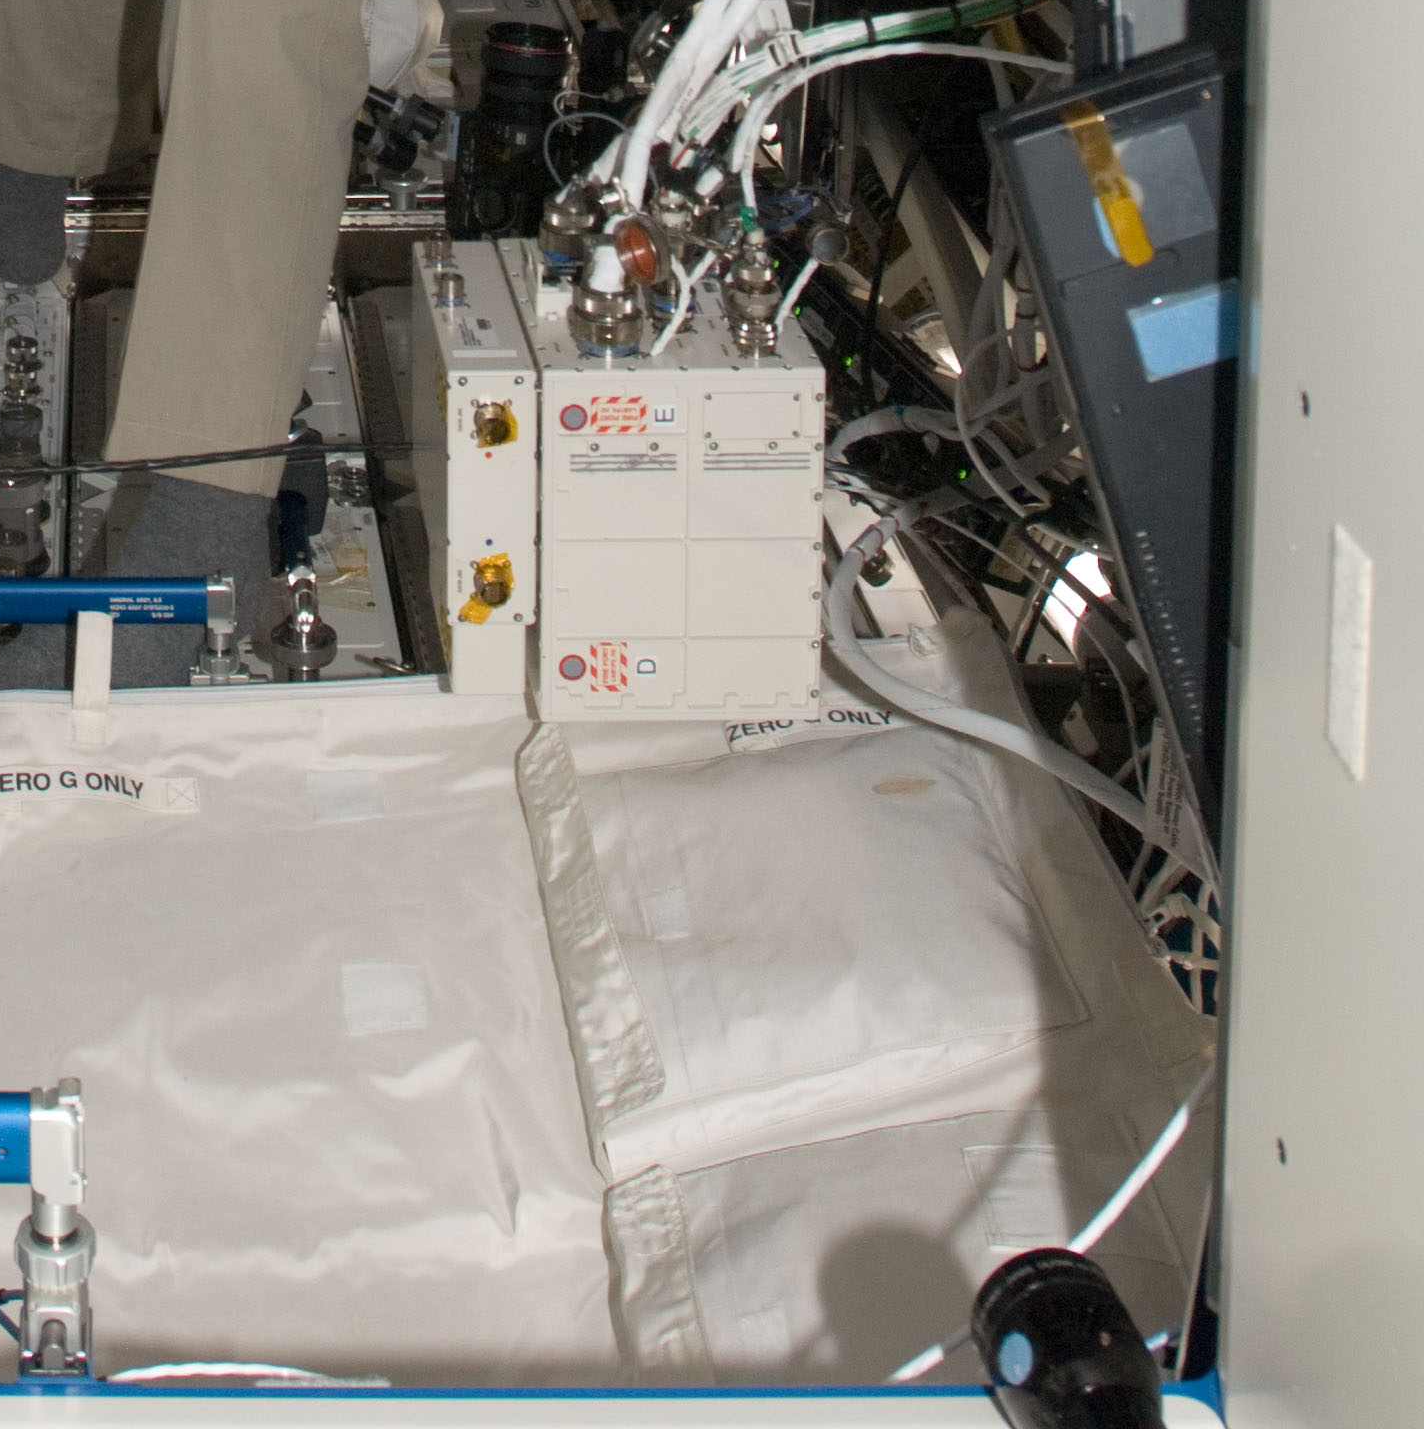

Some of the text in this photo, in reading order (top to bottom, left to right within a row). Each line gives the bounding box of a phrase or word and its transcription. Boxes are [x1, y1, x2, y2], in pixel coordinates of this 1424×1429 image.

[654, 407, 675, 424] E
[637, 658, 657, 675] D
[828, 708, 893, 727] ONLY
[59, 770, 78, 792] G
[85, 772, 144, 800] ONLY
